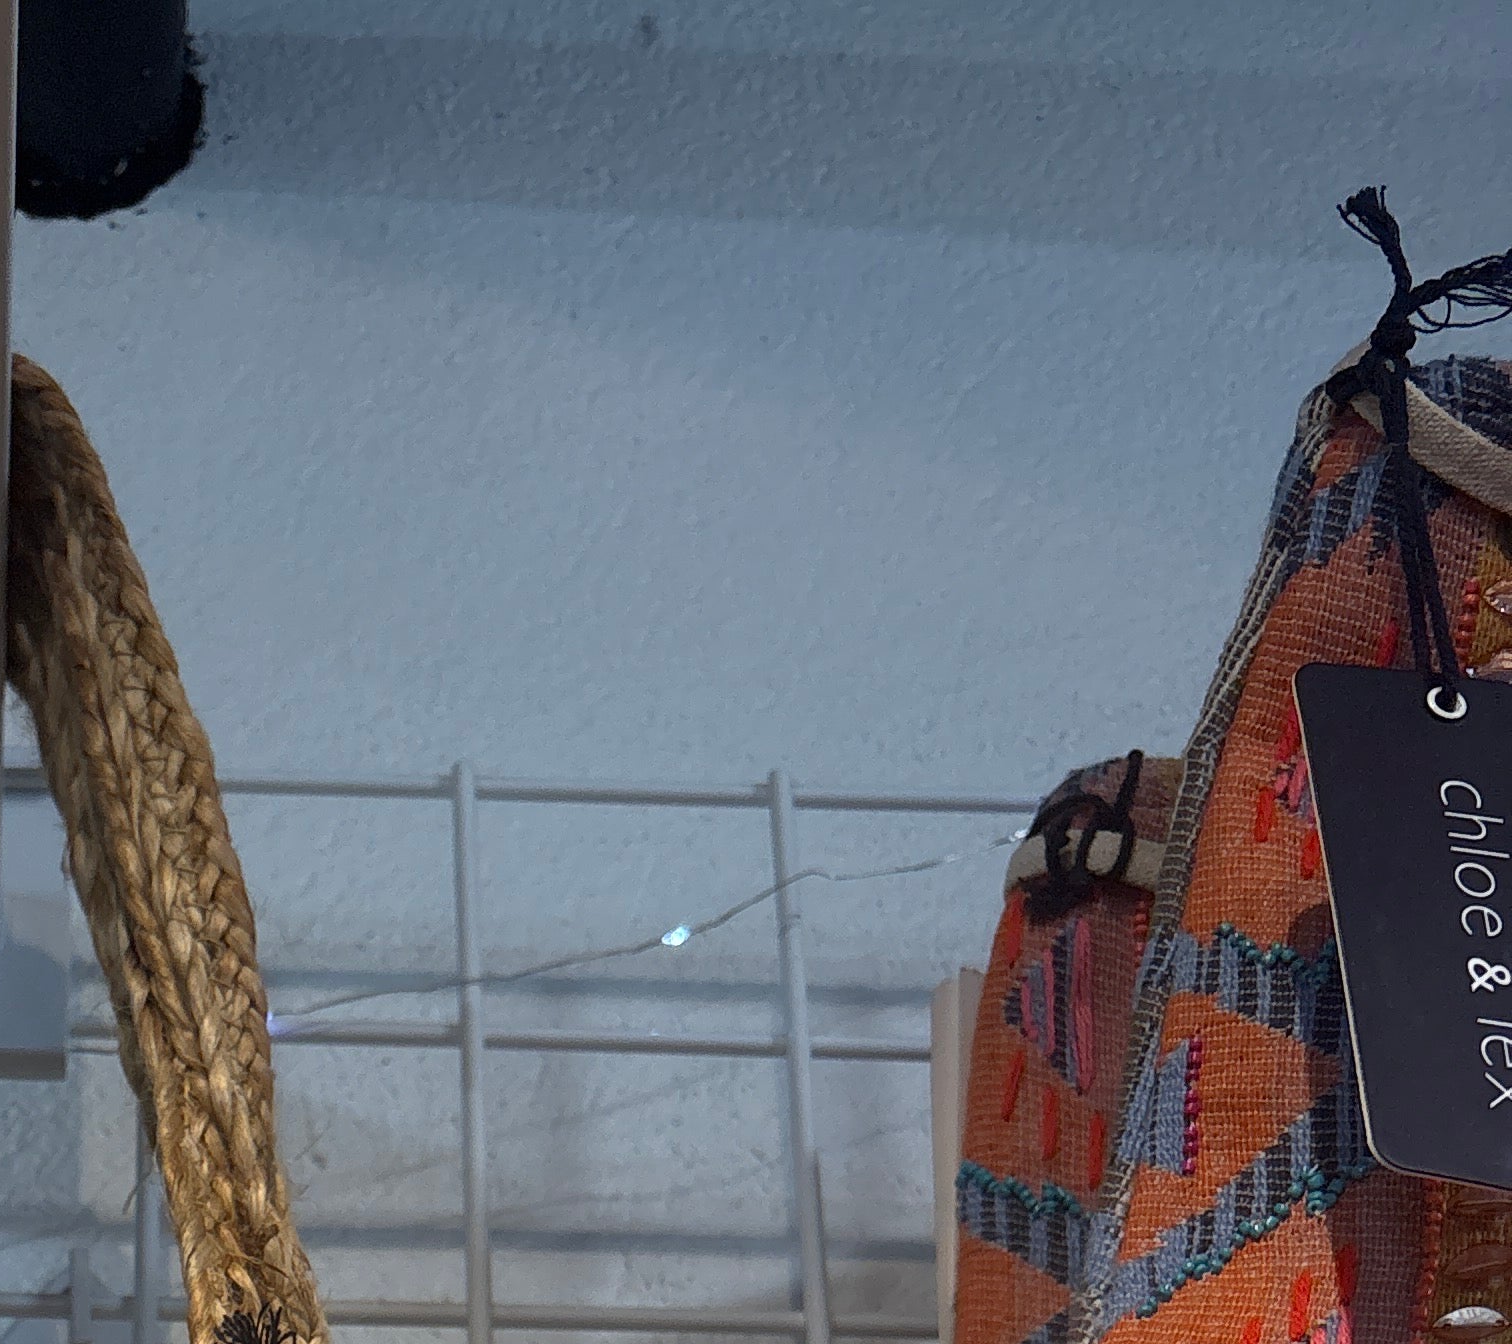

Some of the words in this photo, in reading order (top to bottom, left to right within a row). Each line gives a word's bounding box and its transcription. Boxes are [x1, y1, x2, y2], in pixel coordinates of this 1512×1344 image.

[1440, 780, 1510, 937] chloe
[1467, 957, 1511, 992] &
[1477, 1017, 1512, 1109] lex
